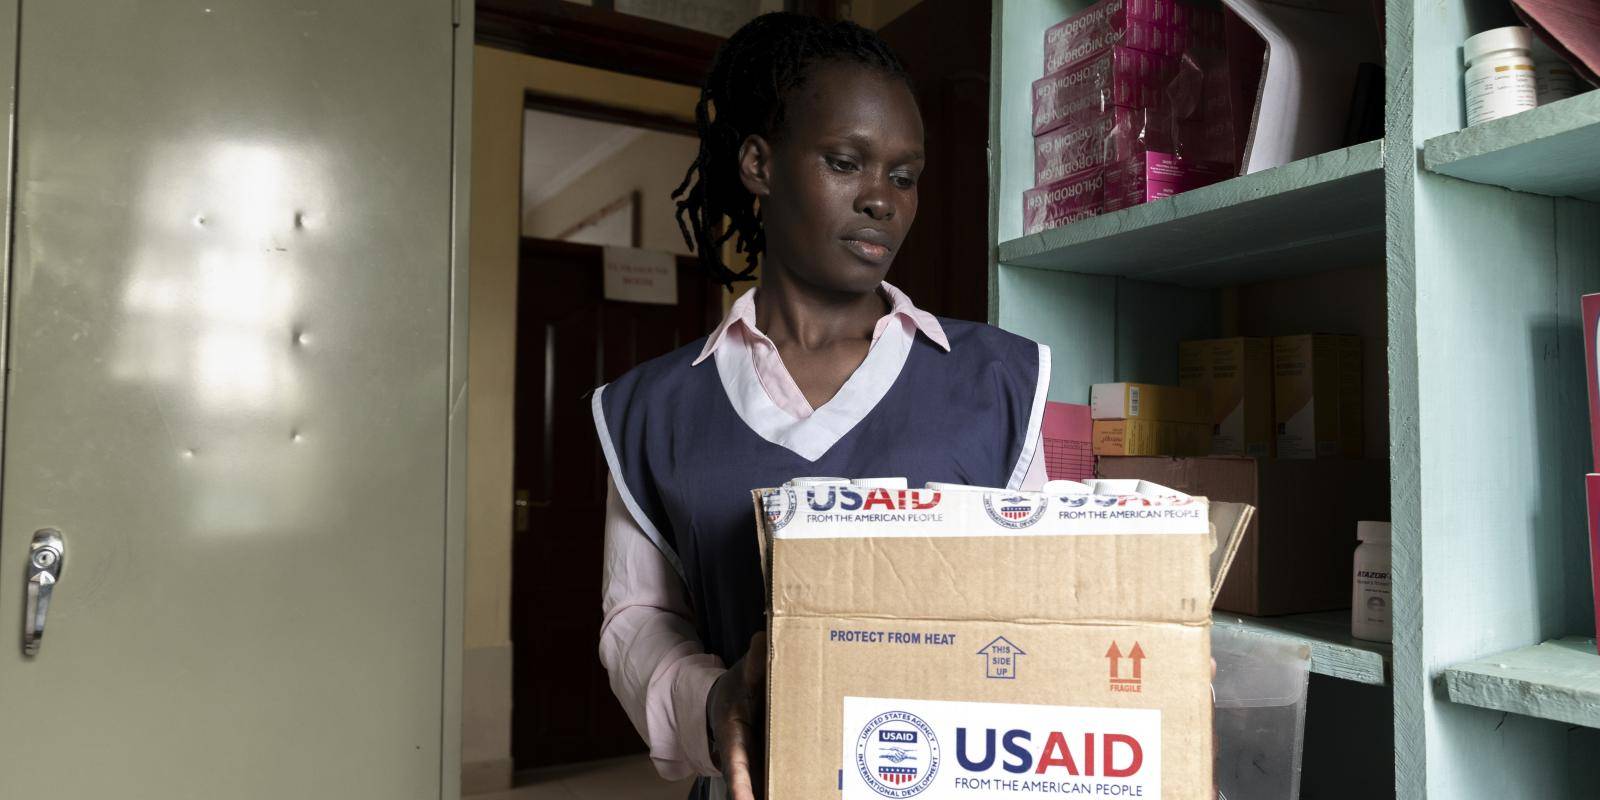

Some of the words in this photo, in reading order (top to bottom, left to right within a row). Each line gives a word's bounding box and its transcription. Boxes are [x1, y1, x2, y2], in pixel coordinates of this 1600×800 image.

[1047, 8, 1103, 44] CHLORODIN
[1047, 37, 1103, 72] CHLORODIN
[1104, 28, 1122, 45] Gel
[1045, 176, 1103, 204] CHLORODIN
[807, 486, 941, 511] USAID
[807, 514, 833, 524] FROM
[834, 514, 853, 523] THE
[855, 514, 905, 523] AMERICAN
[908, 513, 943, 522] PEOPLE
[1059, 511, 1086, 520] FROM
[1089, 511, 1108, 519] THE
[1109, 510, 1162, 519] AMERICAN
[1164, 510, 1200, 519] PEOPLE
[830, 630, 885, 642] PROTECT
[888, 632, 921, 644] FROM
[925, 633, 956, 645] HEAT
[992, 646, 1011, 654] THIS
[992, 657, 1011, 665] SIDE
[997, 668, 1008, 676] UP
[1110, 684, 1142, 693] FRAGILE
[861, 717, 883, 740] UNITED
[884, 713, 910, 721] STATES
[911, 718, 936, 742] AGENCY
[882, 732, 914, 741] USAID
[956, 727, 1143, 778] USAID
[858, 753, 900, 797] INTERNATIONAL
[901, 756, 939, 797] DEVELOPMENT
[955, 777, 991, 790] FROM
[994, 779, 1019, 791] THE
[1021, 780, 1091, 794] AMERICAN
[1096, 783, 1143, 797] PEOPLE
